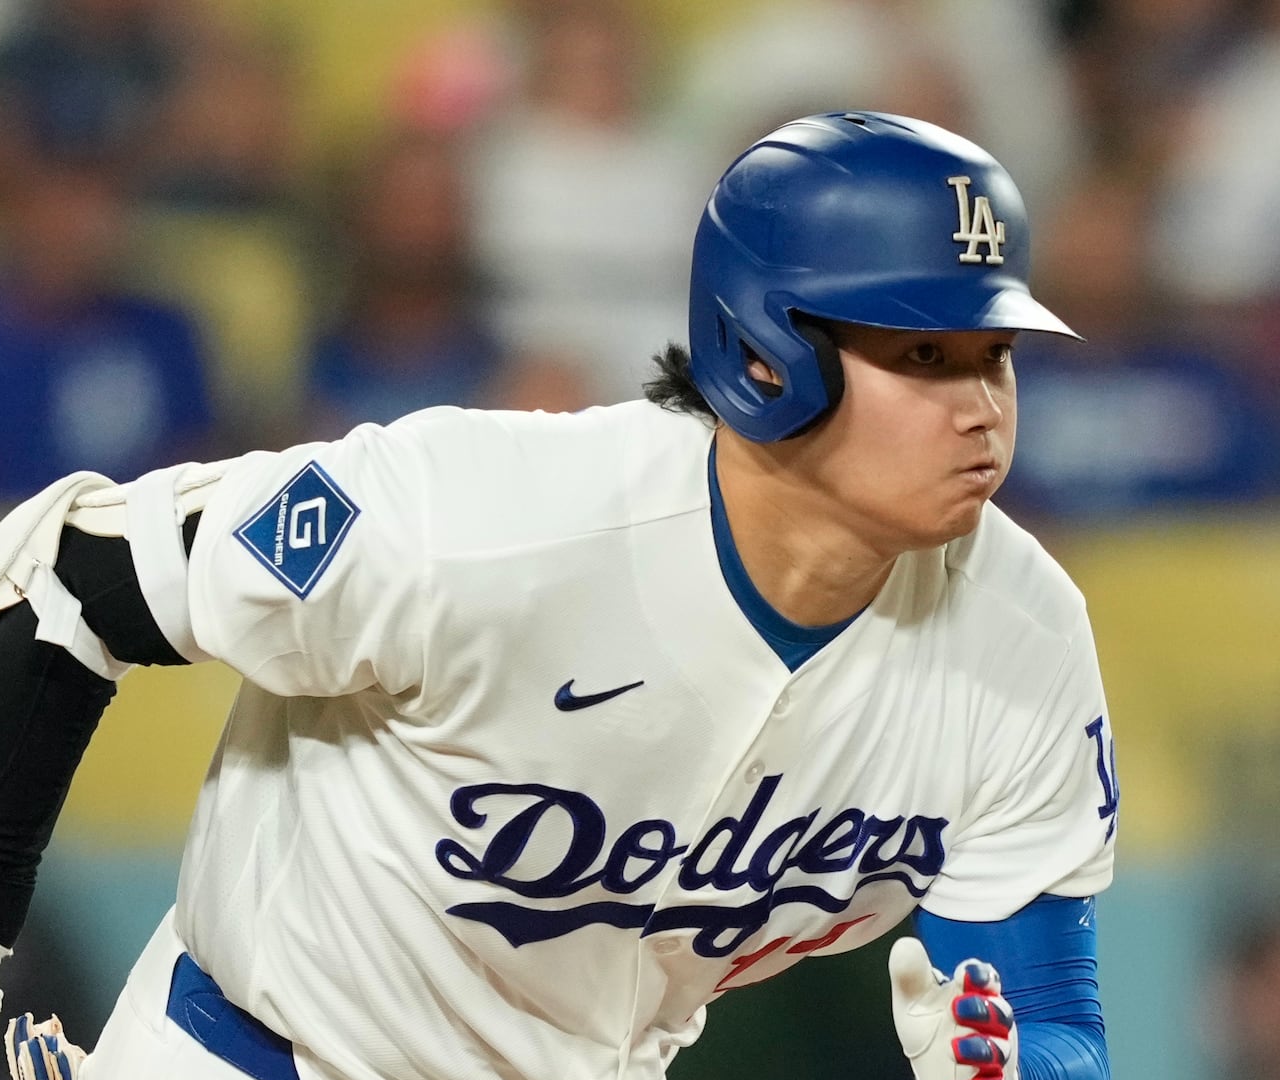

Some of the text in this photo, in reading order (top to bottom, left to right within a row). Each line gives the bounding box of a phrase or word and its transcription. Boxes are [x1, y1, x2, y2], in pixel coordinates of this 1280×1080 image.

[947, 176, 1006, 264] LA
[289, 497, 327, 549] G
[434, 773, 951, 958] Dodgers
